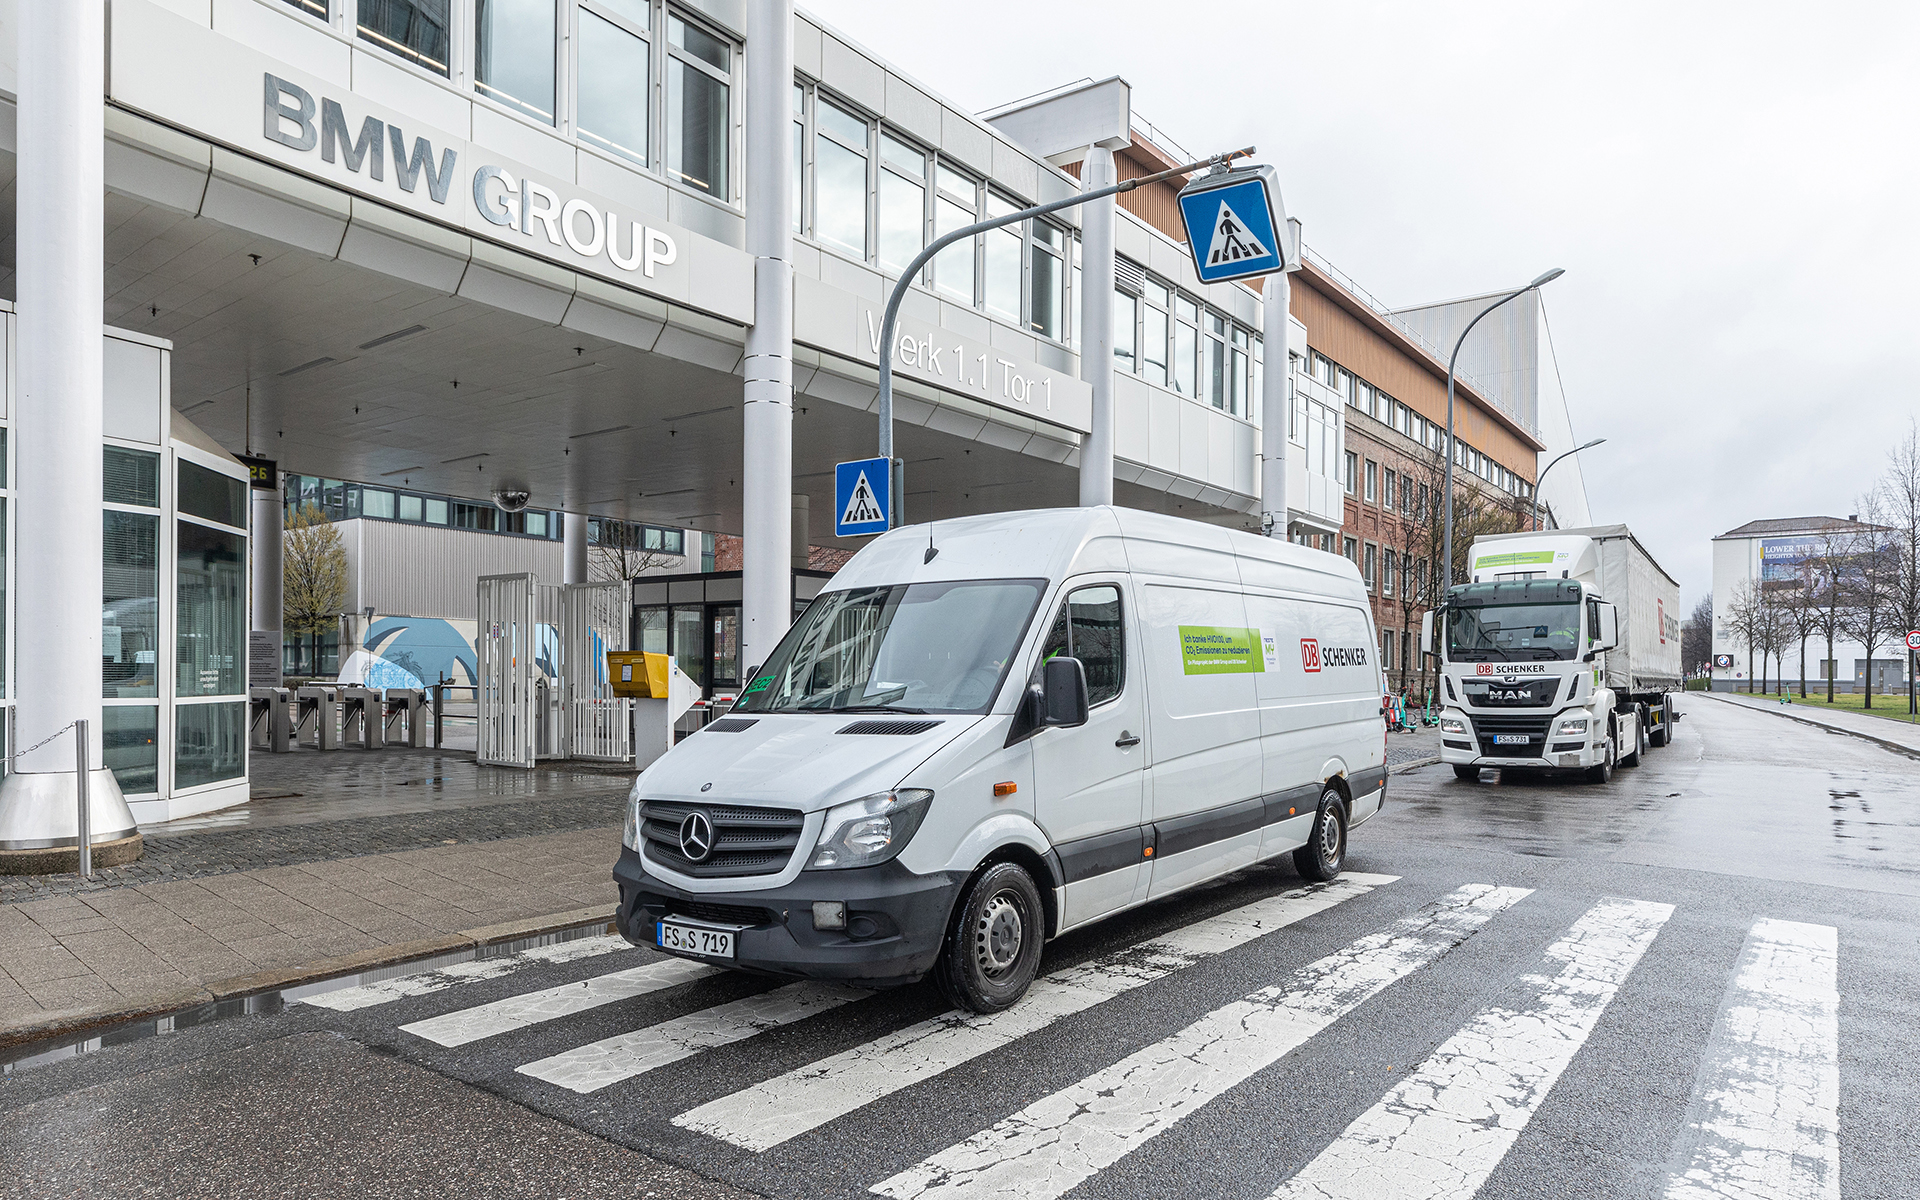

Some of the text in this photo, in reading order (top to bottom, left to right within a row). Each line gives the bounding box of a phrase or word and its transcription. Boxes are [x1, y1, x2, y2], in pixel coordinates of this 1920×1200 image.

[263, 72, 678, 278] BMW GROUP
[866, 309, 1051, 411] Werk 1.1 Tor 1
[1765, 545, 1794, 553] LOWER
[1183, 634, 1192, 643] Ich
[1192, 634, 1207, 643] tanke
[1909, 635, 1920, 645] 30
[1196, 645, 1222, 655] Emissionen
[1228, 646, 1251, 655] reduzieren
[1302, 643, 1368, 667] DB SCHENKER
[1496, 665, 1545, 674] SCHENKER
[1489, 690, 1532, 700] MAN
[664, 926, 728, 954] FS S 719
